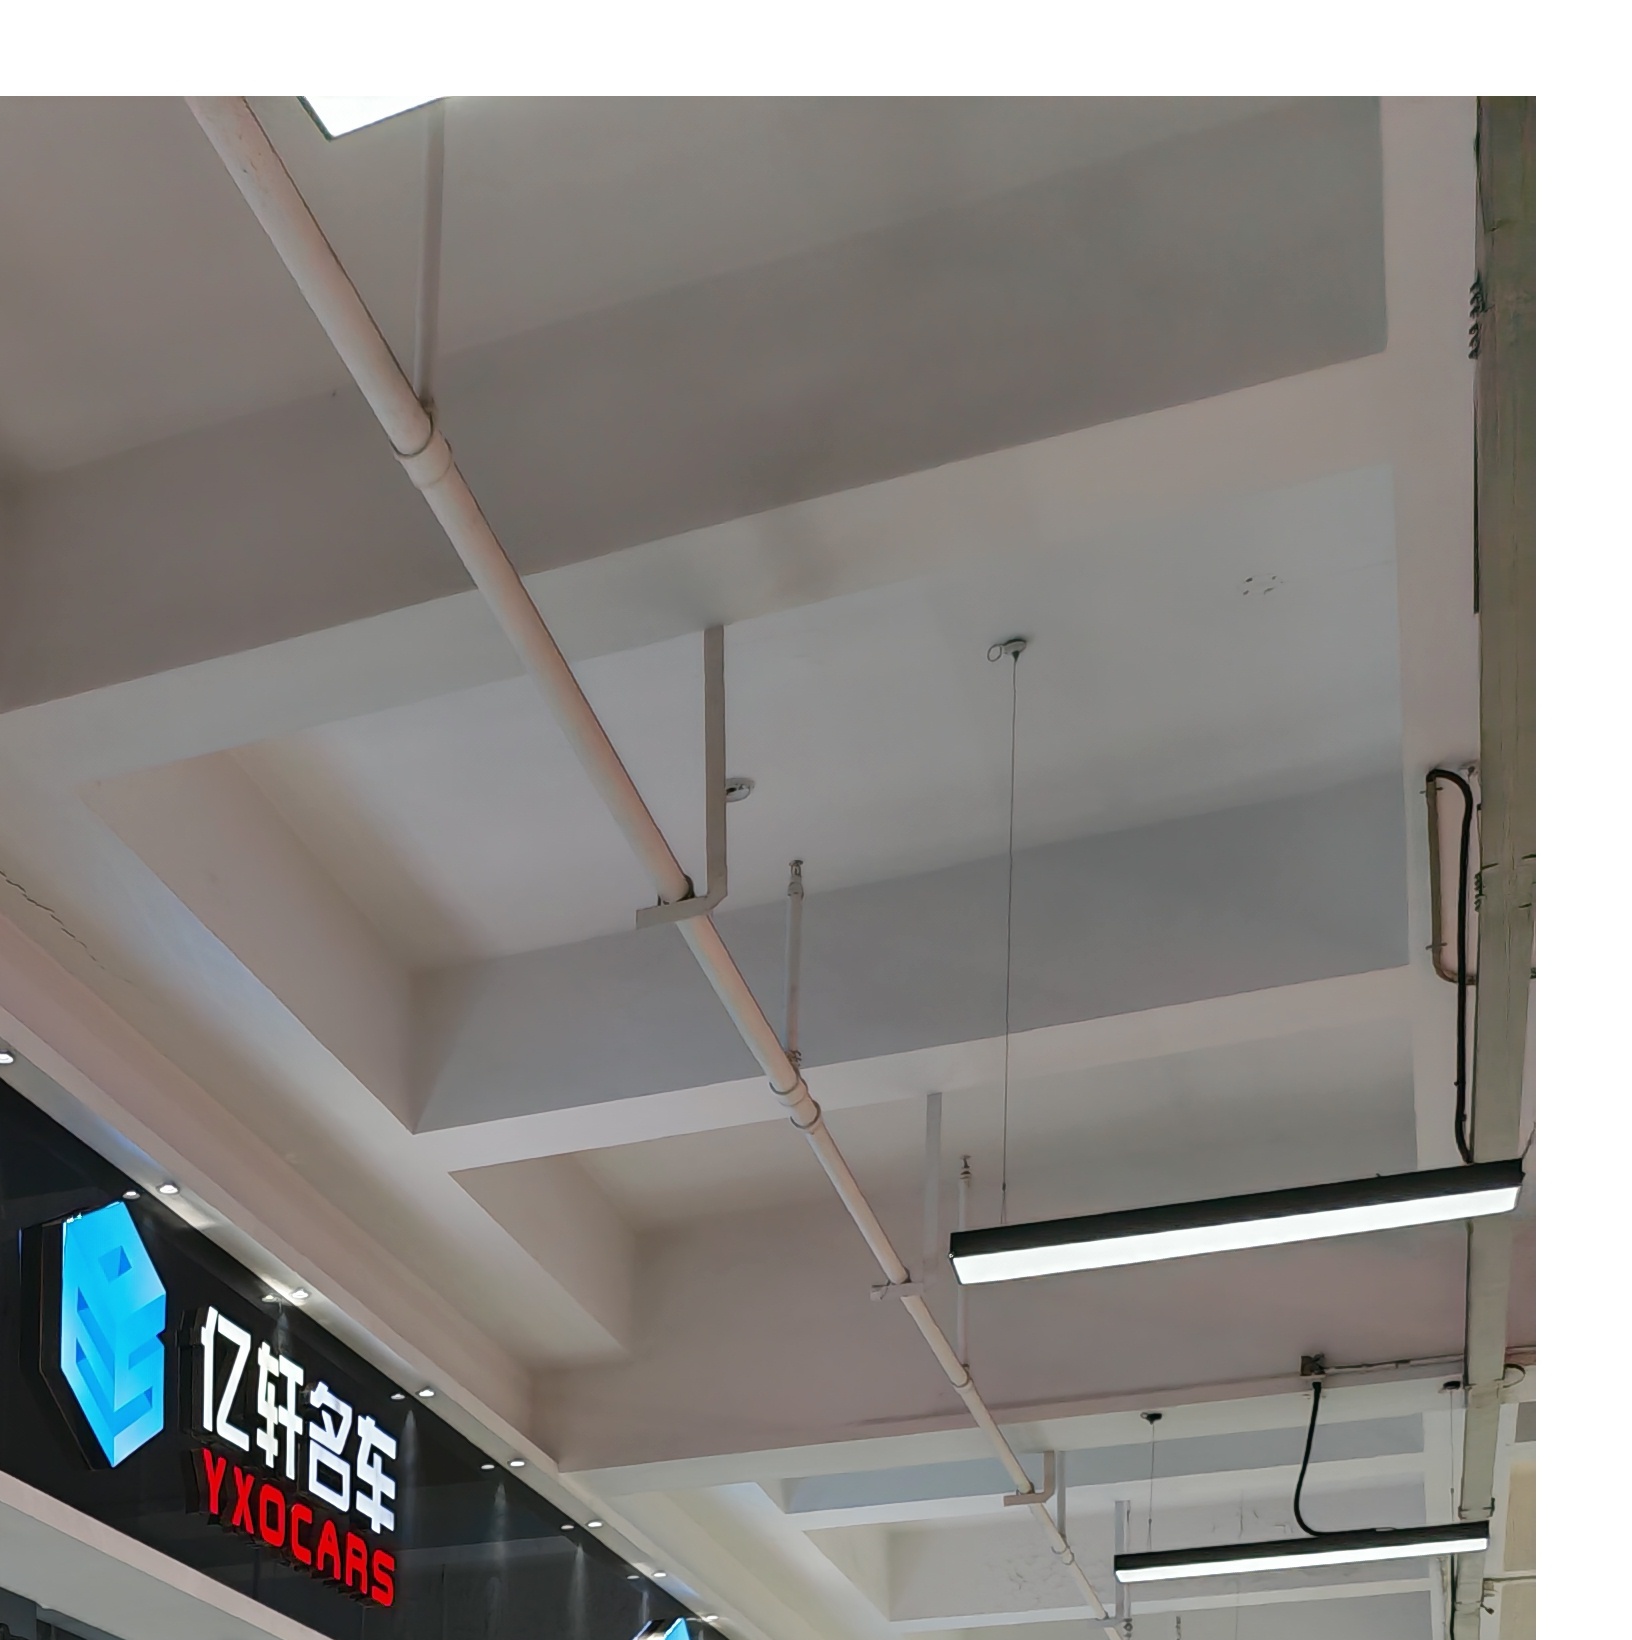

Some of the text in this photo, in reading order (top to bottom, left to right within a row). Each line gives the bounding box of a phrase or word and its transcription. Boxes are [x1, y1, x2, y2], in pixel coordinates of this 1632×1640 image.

[200, 1305, 398, 1535] 亿轩名车
[201, 1446, 396, 1607] YXOCARS
